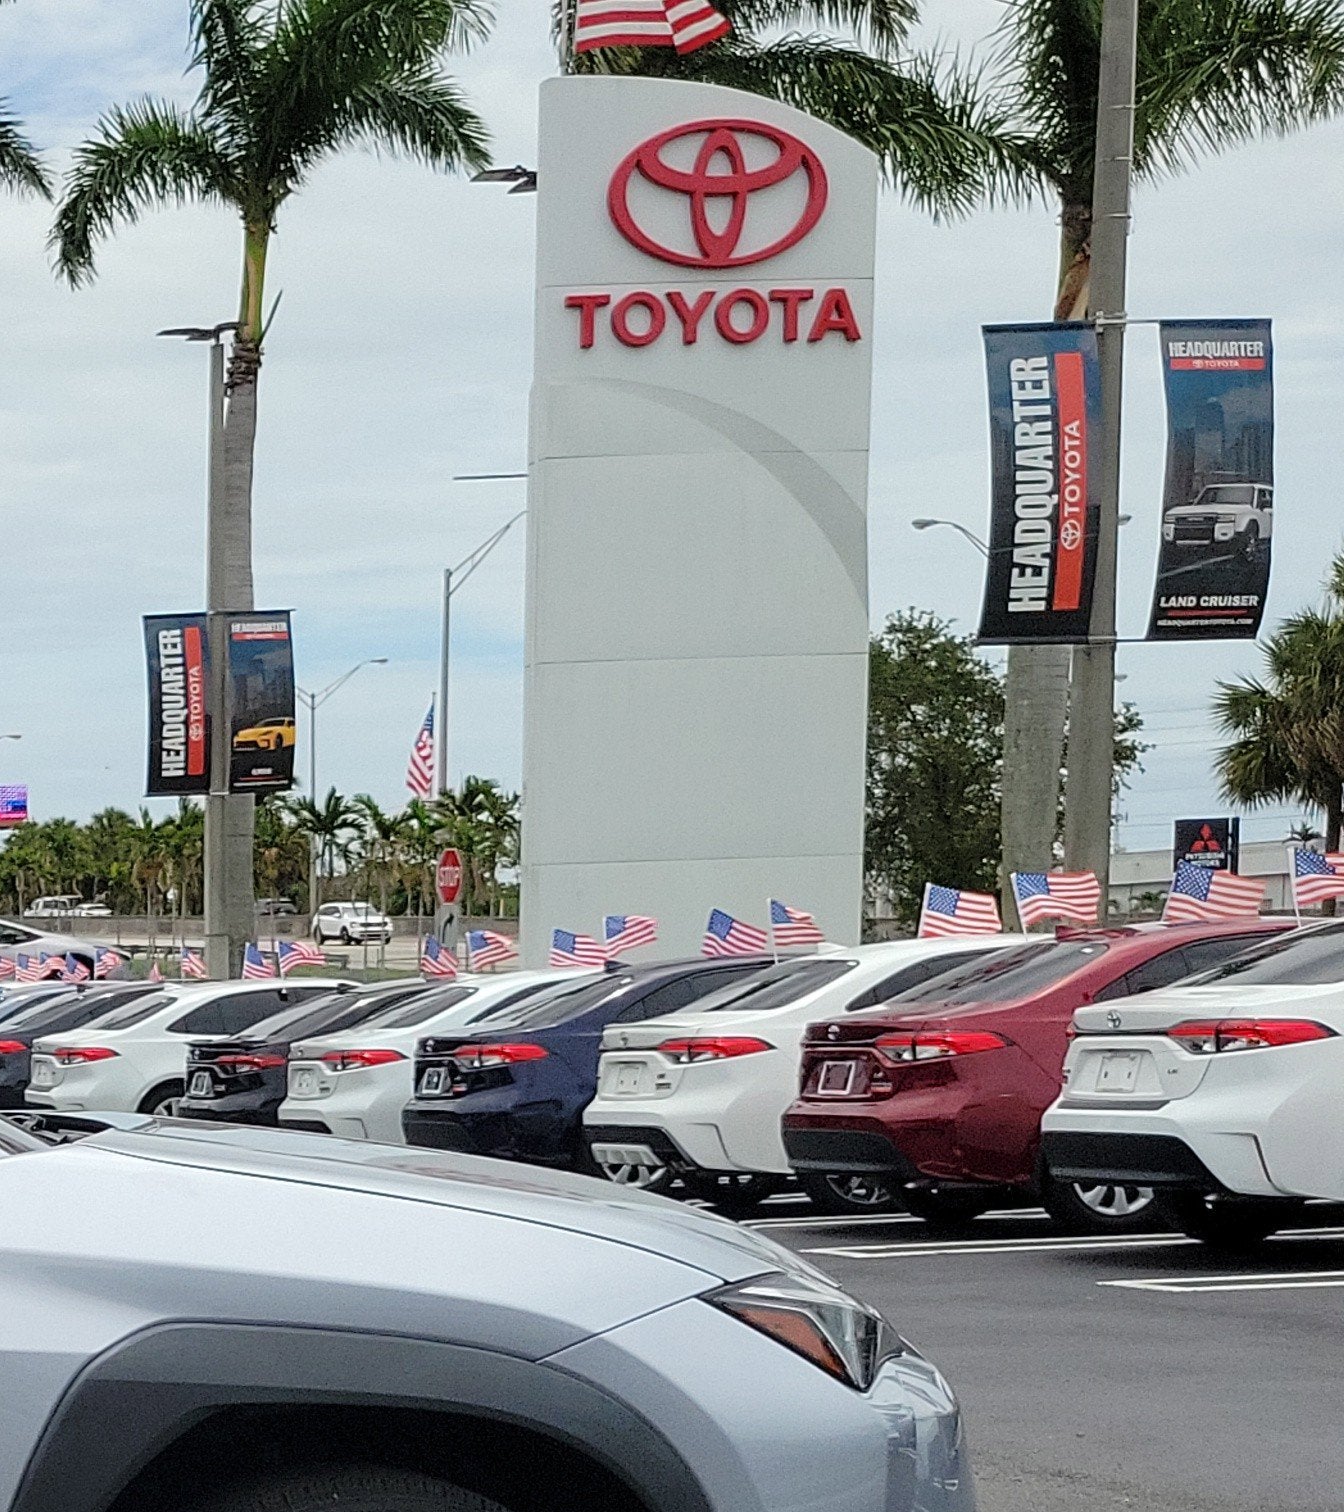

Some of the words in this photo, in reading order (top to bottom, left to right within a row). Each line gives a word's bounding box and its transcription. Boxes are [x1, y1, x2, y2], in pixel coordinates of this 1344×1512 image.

[564, 287, 862, 349] TOYOTA
[1168, 341, 1264, 359] HEADQUARTER
[1008, 356, 1059, 612] HEADQUARTER
[1064, 420, 1081, 517] TOYOTA
[1159, 595, 1197, 607] LAND
[1199, 594, 1260, 607] CRUISER
[159, 628, 188, 778] HEADQUARTER
[189, 665, 204, 723] TOYOTA
[439, 865, 460, 887] STOP
